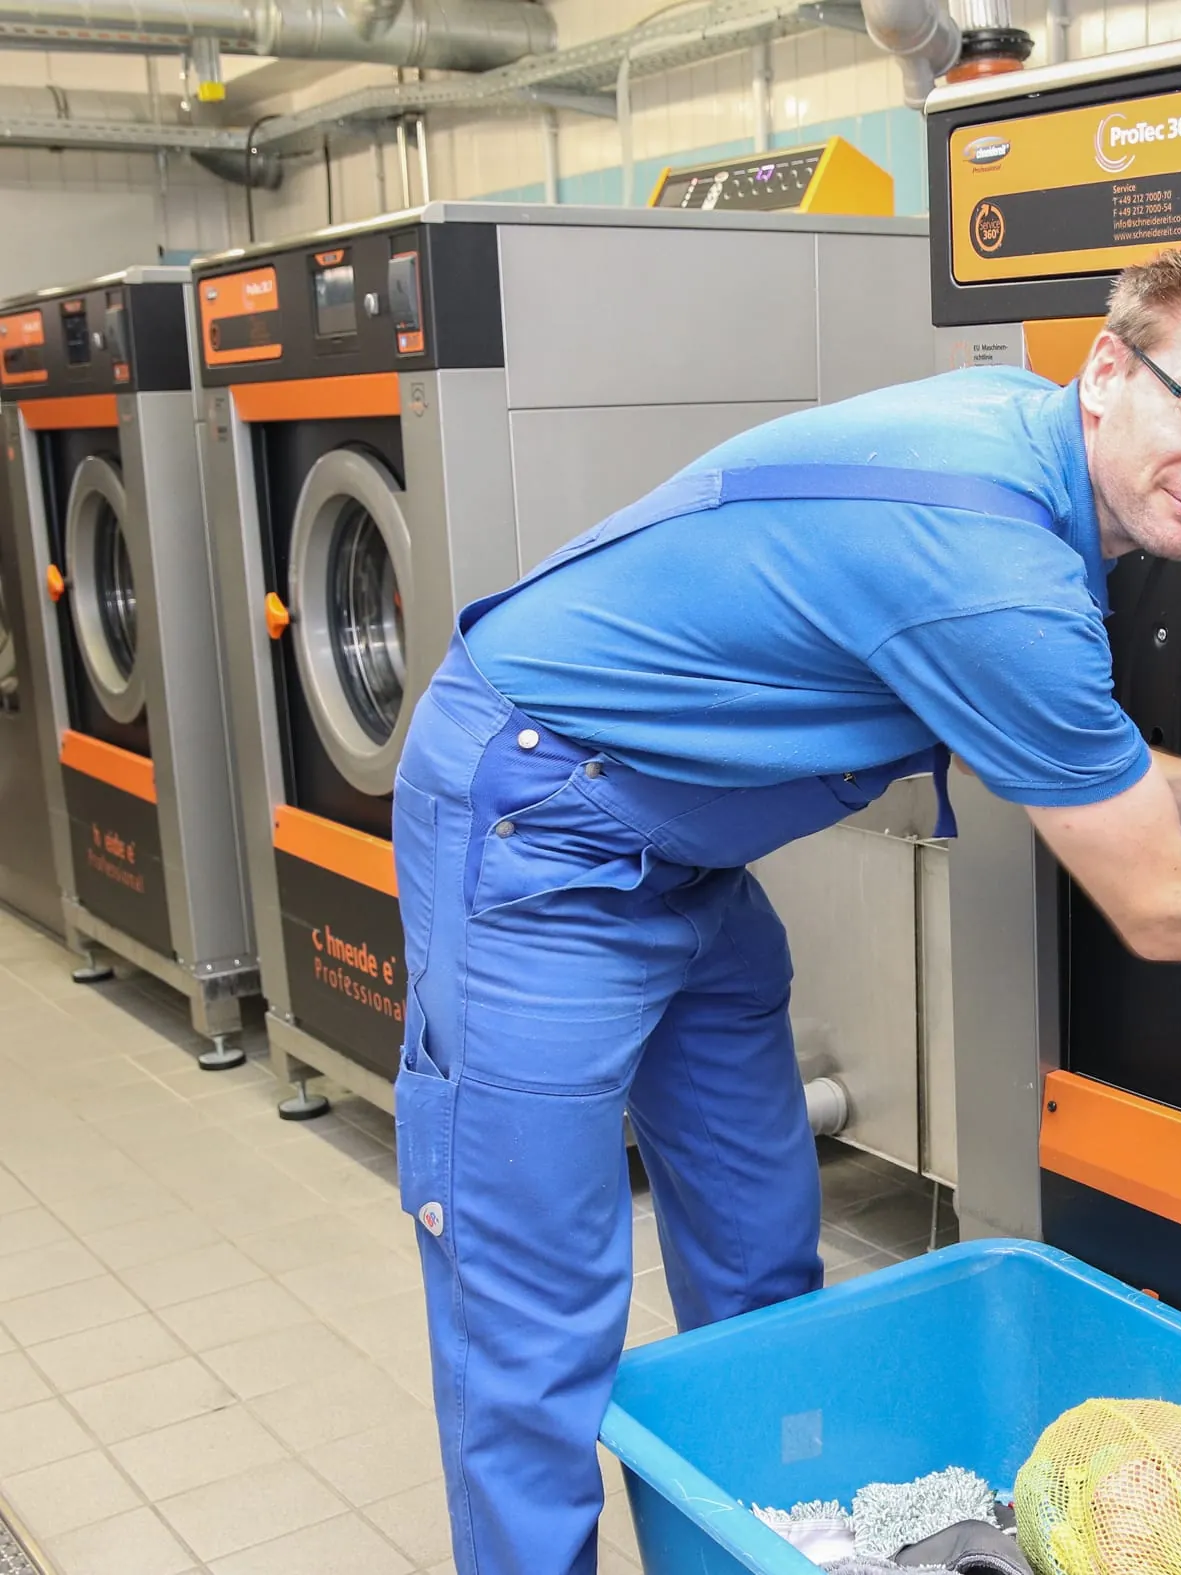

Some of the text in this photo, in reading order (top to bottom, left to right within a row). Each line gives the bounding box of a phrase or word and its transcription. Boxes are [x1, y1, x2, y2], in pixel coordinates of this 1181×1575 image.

[1110, 122, 1165, 147] ProTec
[1112, 183, 1137, 195] Service
[1119, 195, 1131, 204] +49
[1132, 193, 1145, 204] 212
[1112, 202, 1172, 217] F +49 212 7000-54
